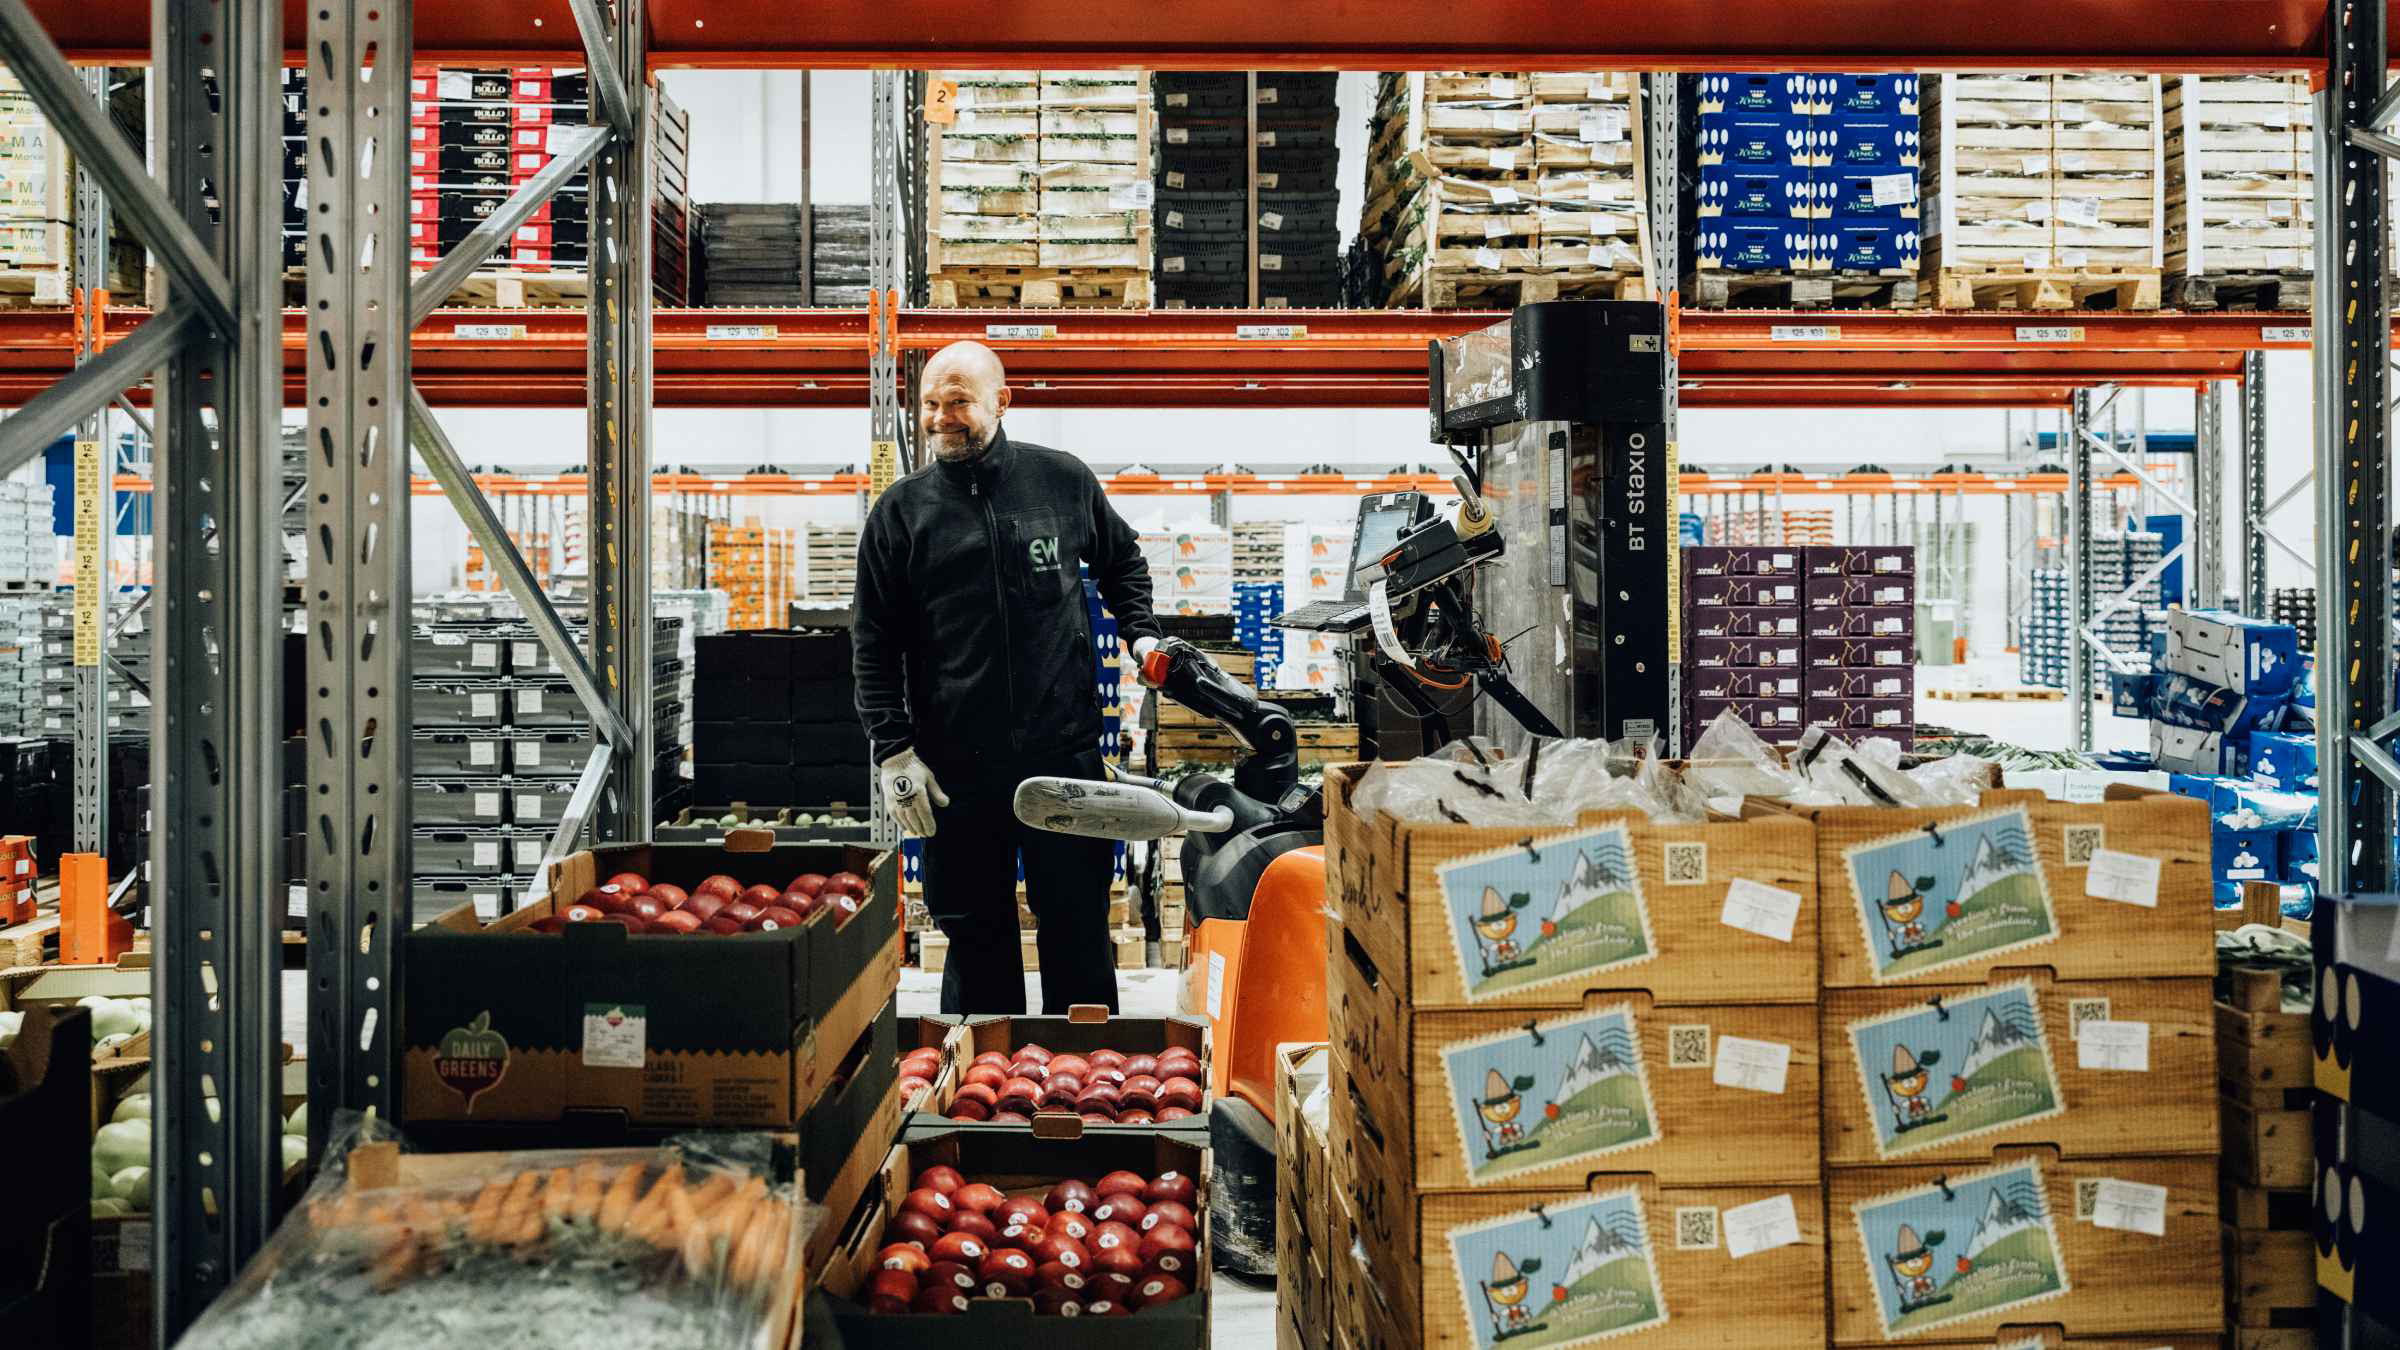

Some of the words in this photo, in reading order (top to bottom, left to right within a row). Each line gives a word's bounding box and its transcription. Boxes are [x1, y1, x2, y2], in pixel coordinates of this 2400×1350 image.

[474, 85, 506, 94] BOLLO
[936, 89, 946, 103] 2
[474, 109, 506, 117] BOLLO
[474, 133, 506, 141] BOLLO
[474, 157, 506, 165] BOLLO
[82, 443, 93, 452] 12
[878, 443, 889, 452] 12
[82, 499, 93, 508] 12
[1628, 522, 1645, 551] BT
[82, 555, 93, 564] 12
[82, 611, 92, 619] 12
[451, 1040, 491, 1058] DAILY
[439, 1060, 498, 1078] GREENS
